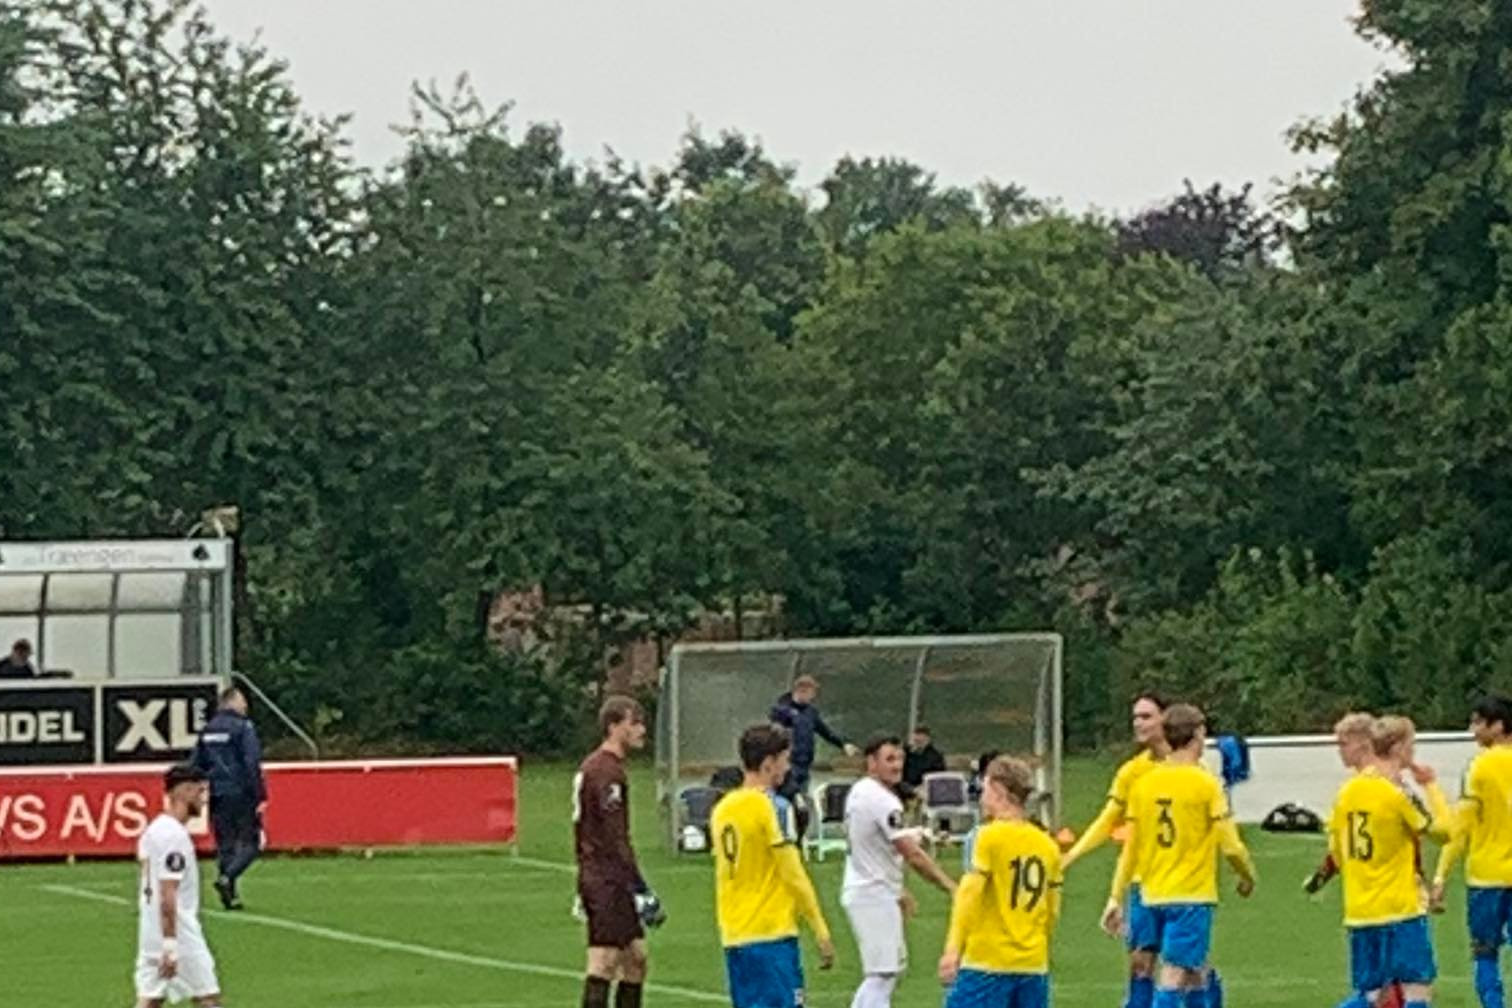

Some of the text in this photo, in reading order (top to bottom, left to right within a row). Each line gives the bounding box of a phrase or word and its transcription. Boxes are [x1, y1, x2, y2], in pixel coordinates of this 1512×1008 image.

[60, 791, 149, 843] A/S
[1154, 798, 1177, 849] 3
[1347, 811, 1374, 862] 13
[1008, 854, 1045, 913] 19
